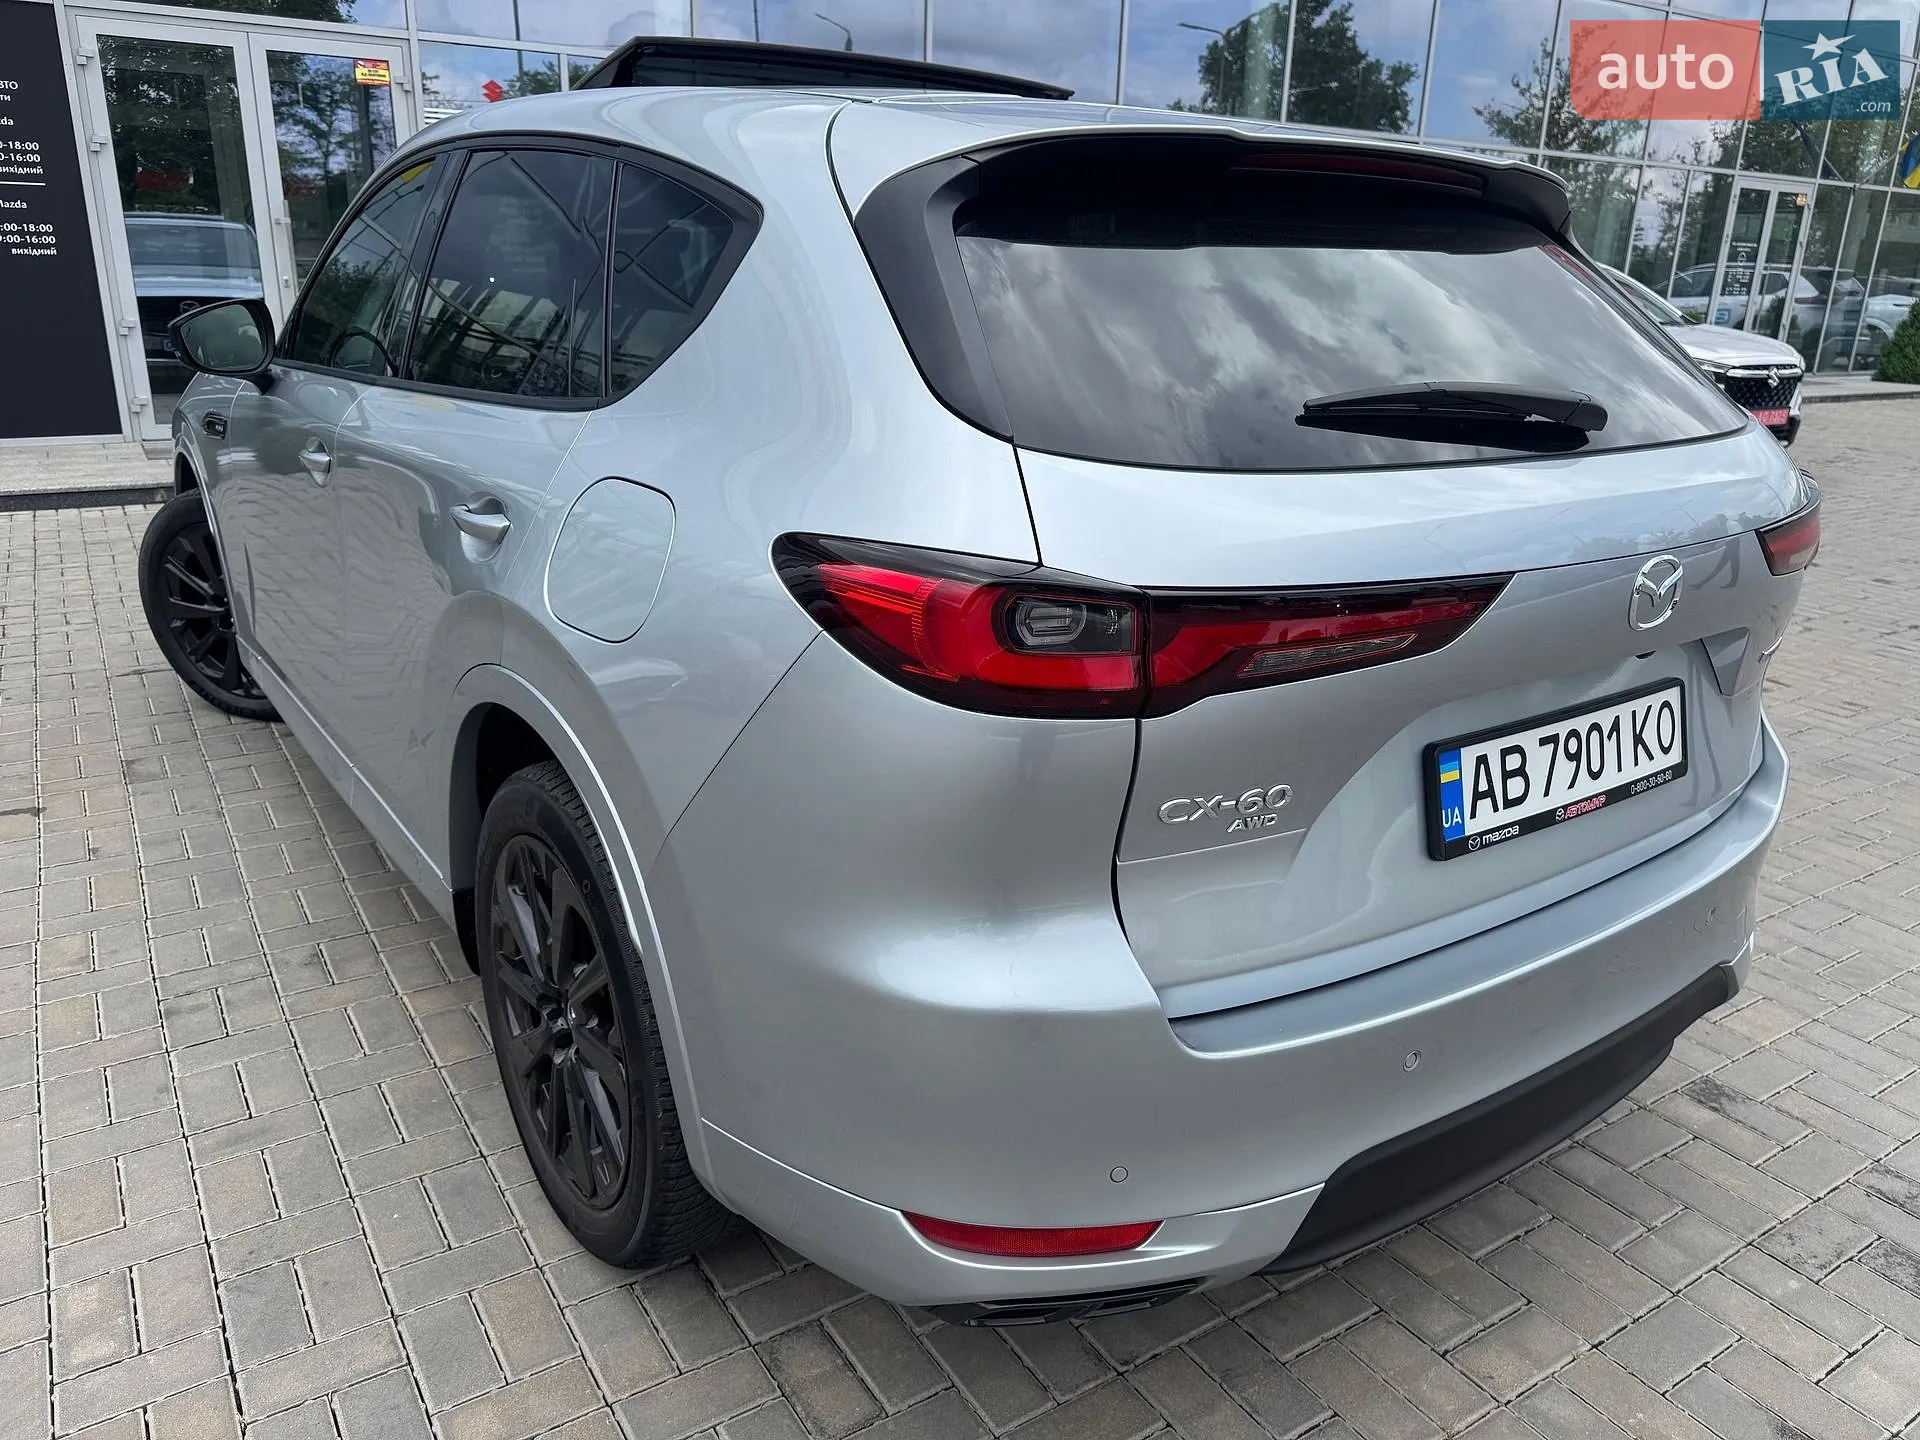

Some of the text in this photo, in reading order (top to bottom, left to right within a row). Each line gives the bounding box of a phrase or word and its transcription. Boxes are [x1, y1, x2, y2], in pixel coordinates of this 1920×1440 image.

[11, 246, 58, 256] вихідний
[1538, 714, 1623, 798] 7901
[1158, 784, 1294, 824] CX-60
[1226, 813, 1279, 833] AWD
[1442, 806, 1462, 828] UA
